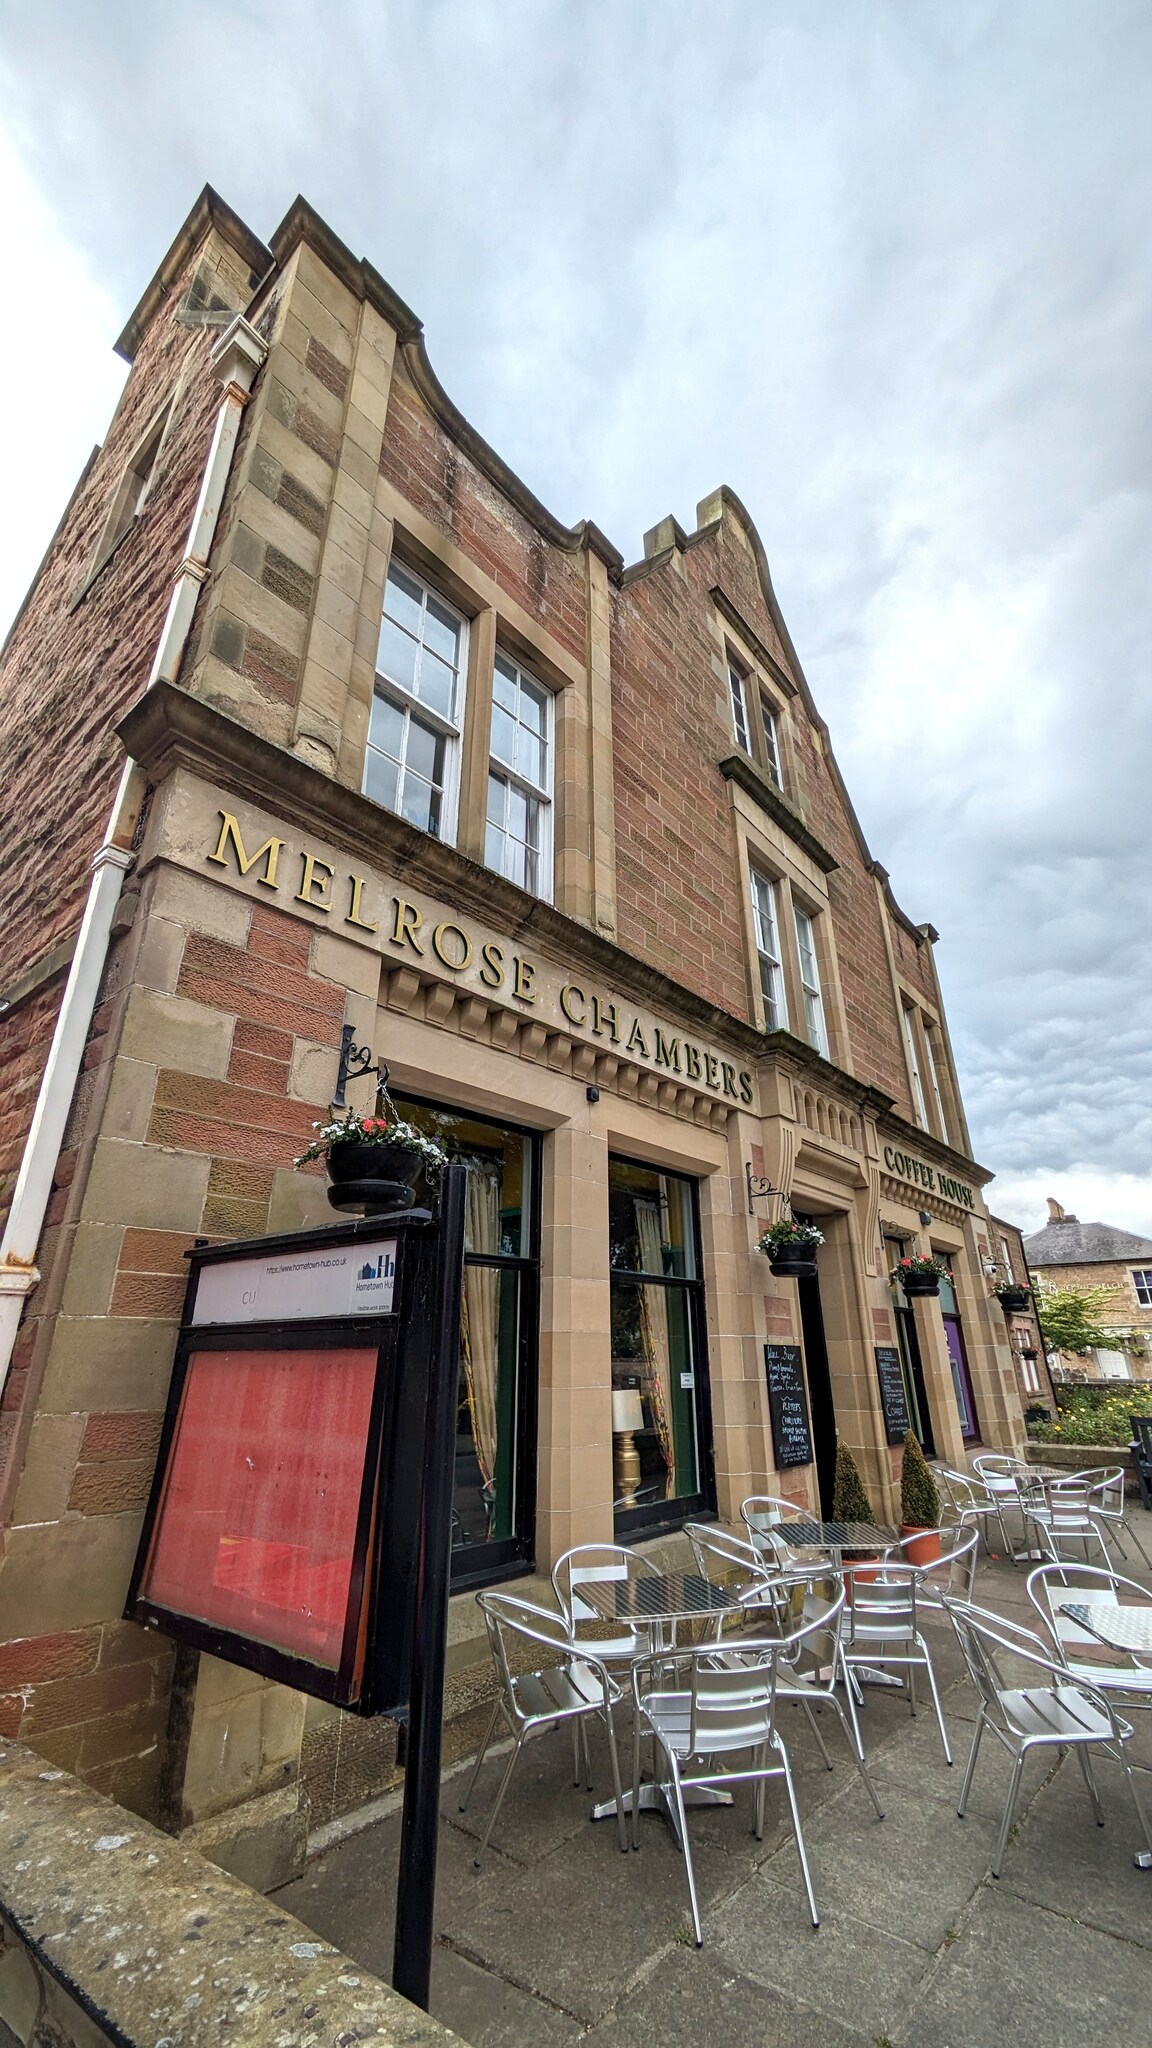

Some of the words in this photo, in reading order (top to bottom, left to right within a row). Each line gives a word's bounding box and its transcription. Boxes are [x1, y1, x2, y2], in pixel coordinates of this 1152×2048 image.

[206, 809, 537, 1005] MELROSE
[560, 984, 754, 1103] CHAMBERS
[884, 1146, 936, 1189] COFFEE
[937, 1172, 975, 1209] HOUSE
[356, 1282, 383, 1291] Hometown
[1093, 1282, 1125, 1290] WELCH
